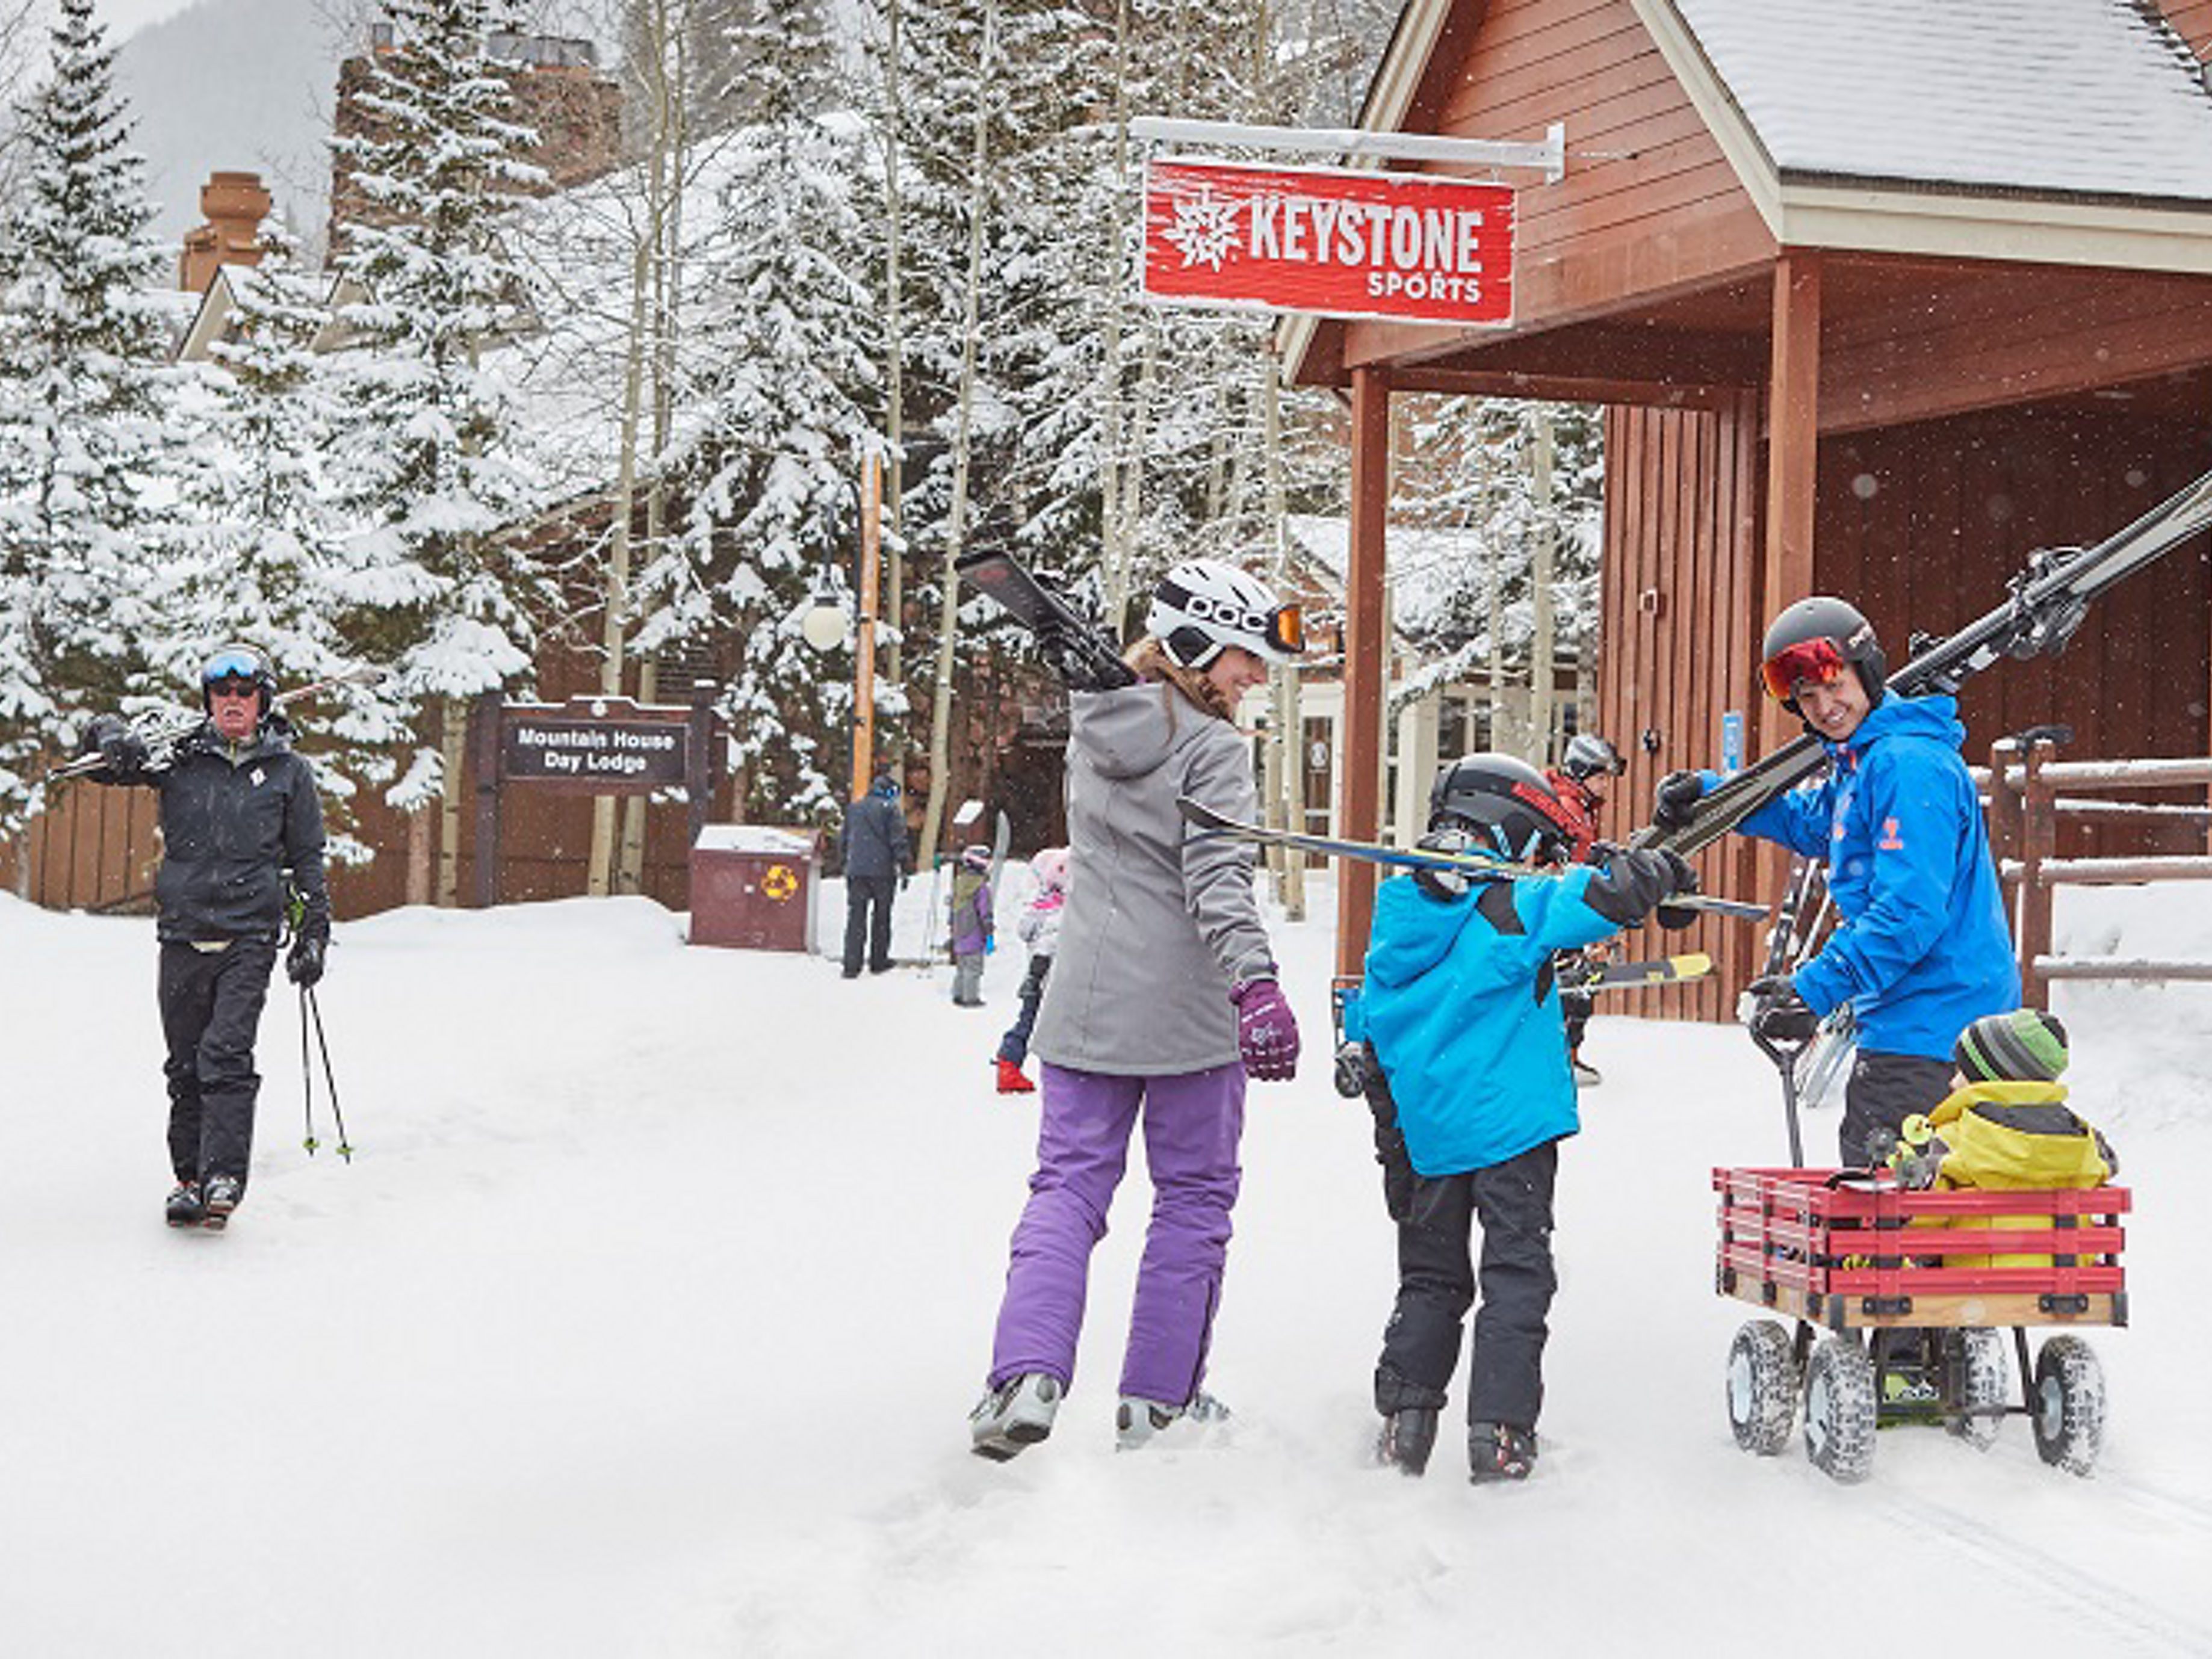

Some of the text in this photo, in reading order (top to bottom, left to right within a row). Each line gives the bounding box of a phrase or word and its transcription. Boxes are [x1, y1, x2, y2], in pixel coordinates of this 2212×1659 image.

[1249, 193, 1484, 273] KEYSTONE
[1367, 271, 1482, 302] SPORTS
[518, 728, 675, 750] Mountain House
[545, 752, 646, 773] Day Lodge
